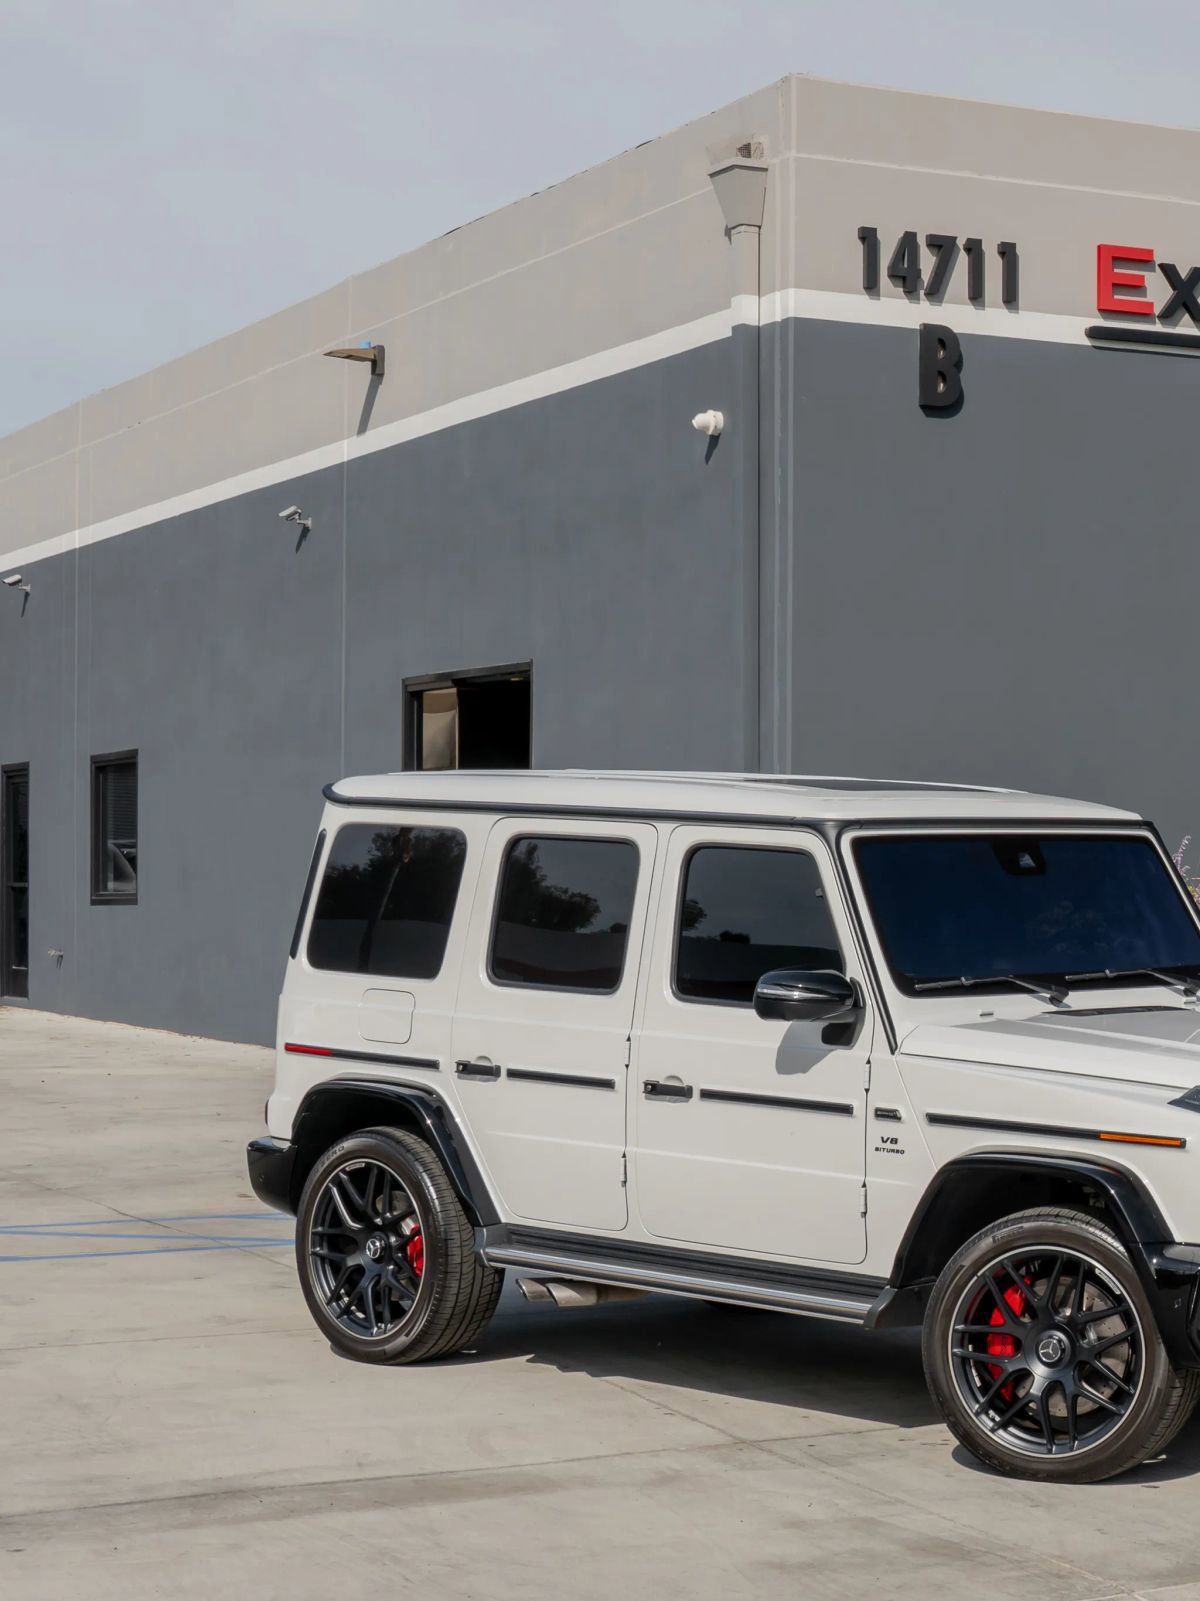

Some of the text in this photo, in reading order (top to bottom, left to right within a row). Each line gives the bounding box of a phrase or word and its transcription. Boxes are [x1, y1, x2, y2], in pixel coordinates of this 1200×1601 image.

[857, 226, 1018, 302] 14711
[919, 323, 964, 412] B
[874, 1146, 905, 1154] BITURBO
[880, 1136, 899, 1145] V8
